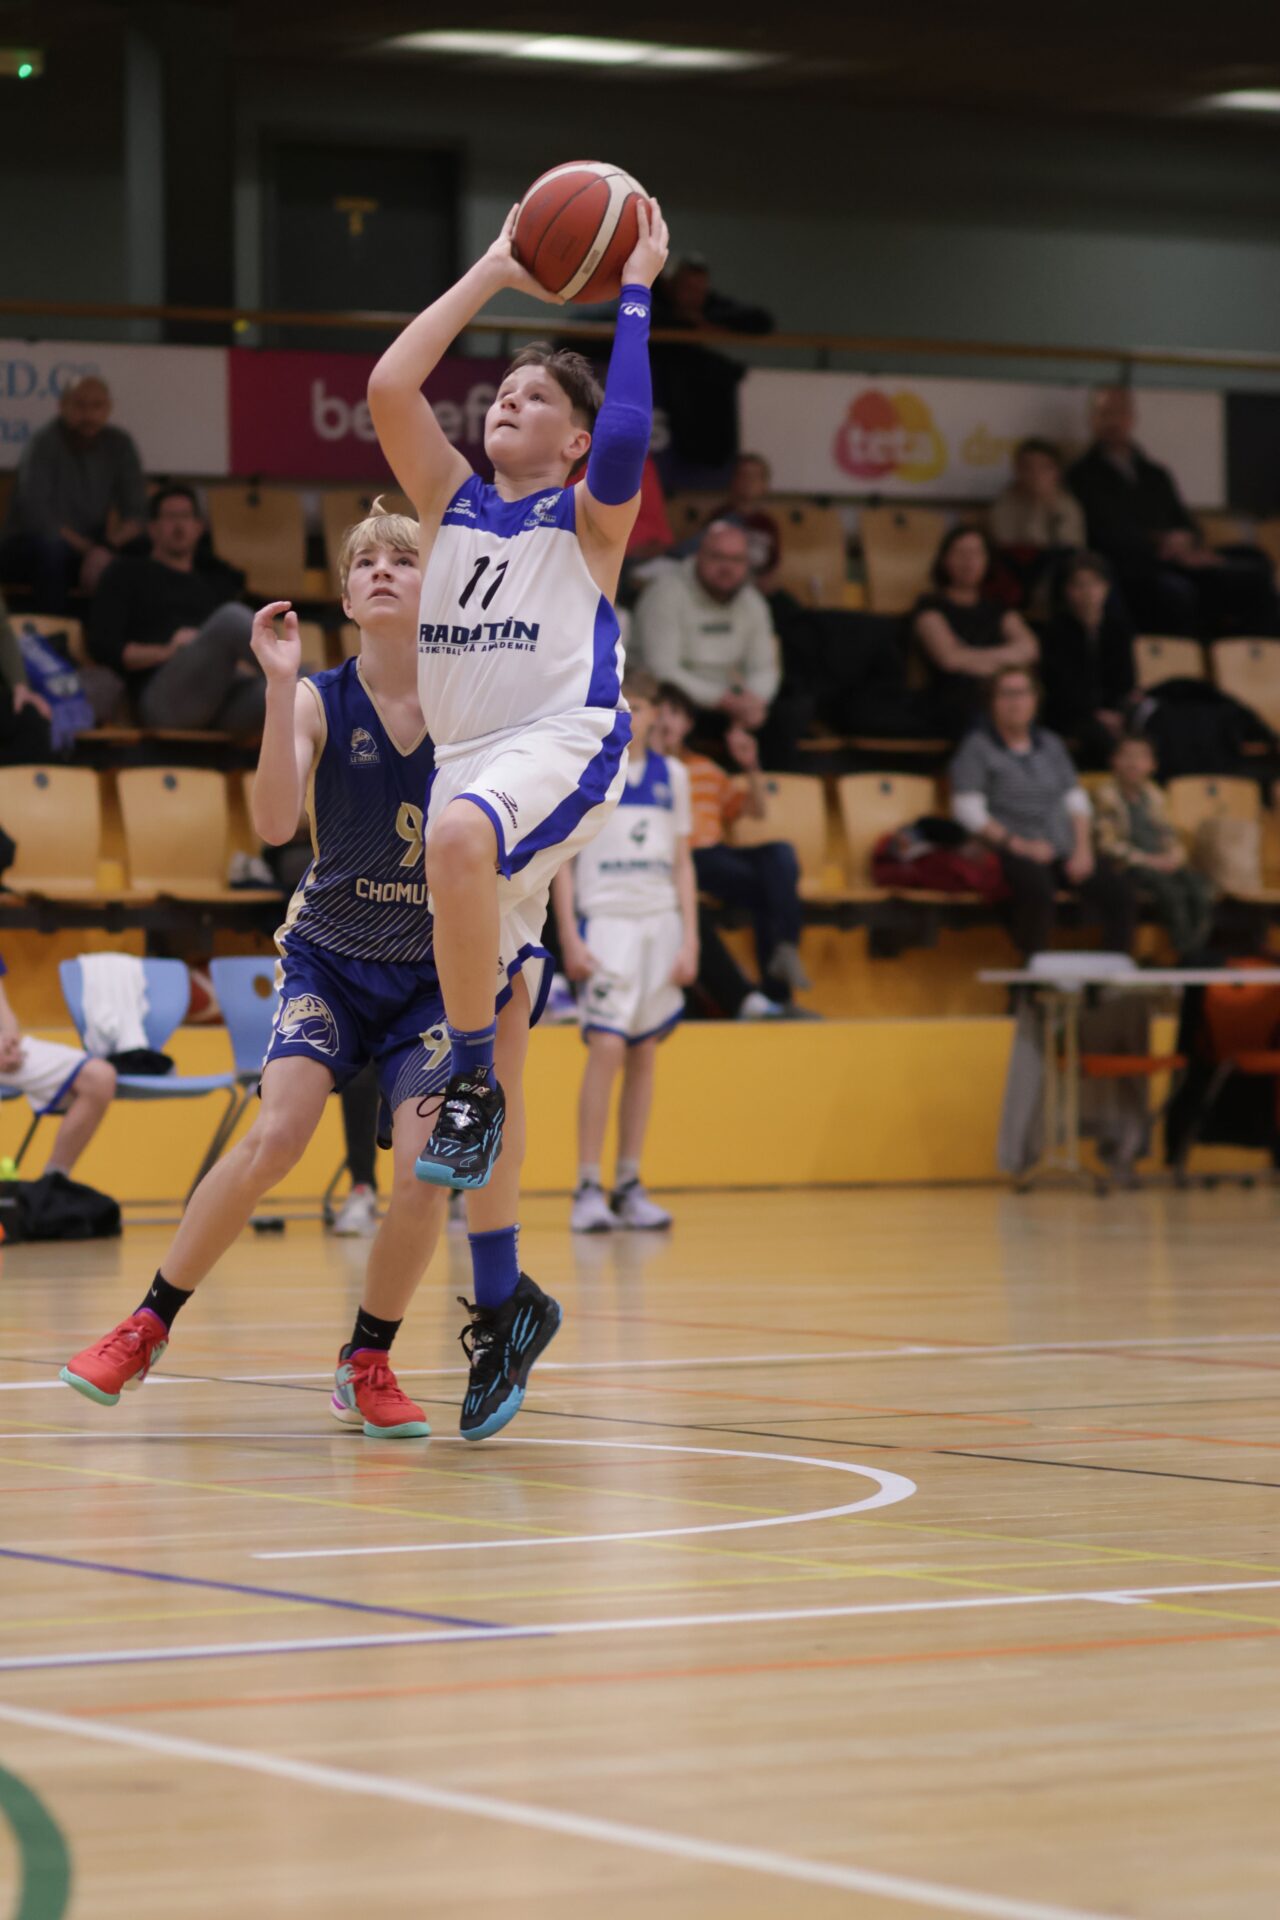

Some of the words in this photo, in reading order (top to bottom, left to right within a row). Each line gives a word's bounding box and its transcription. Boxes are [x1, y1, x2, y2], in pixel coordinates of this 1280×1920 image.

[458, 555, 509, 611] 11
[395, 801, 423, 867] 9
[356, 877, 428, 905] CHOMU
[418, 1021, 452, 1071] 9
